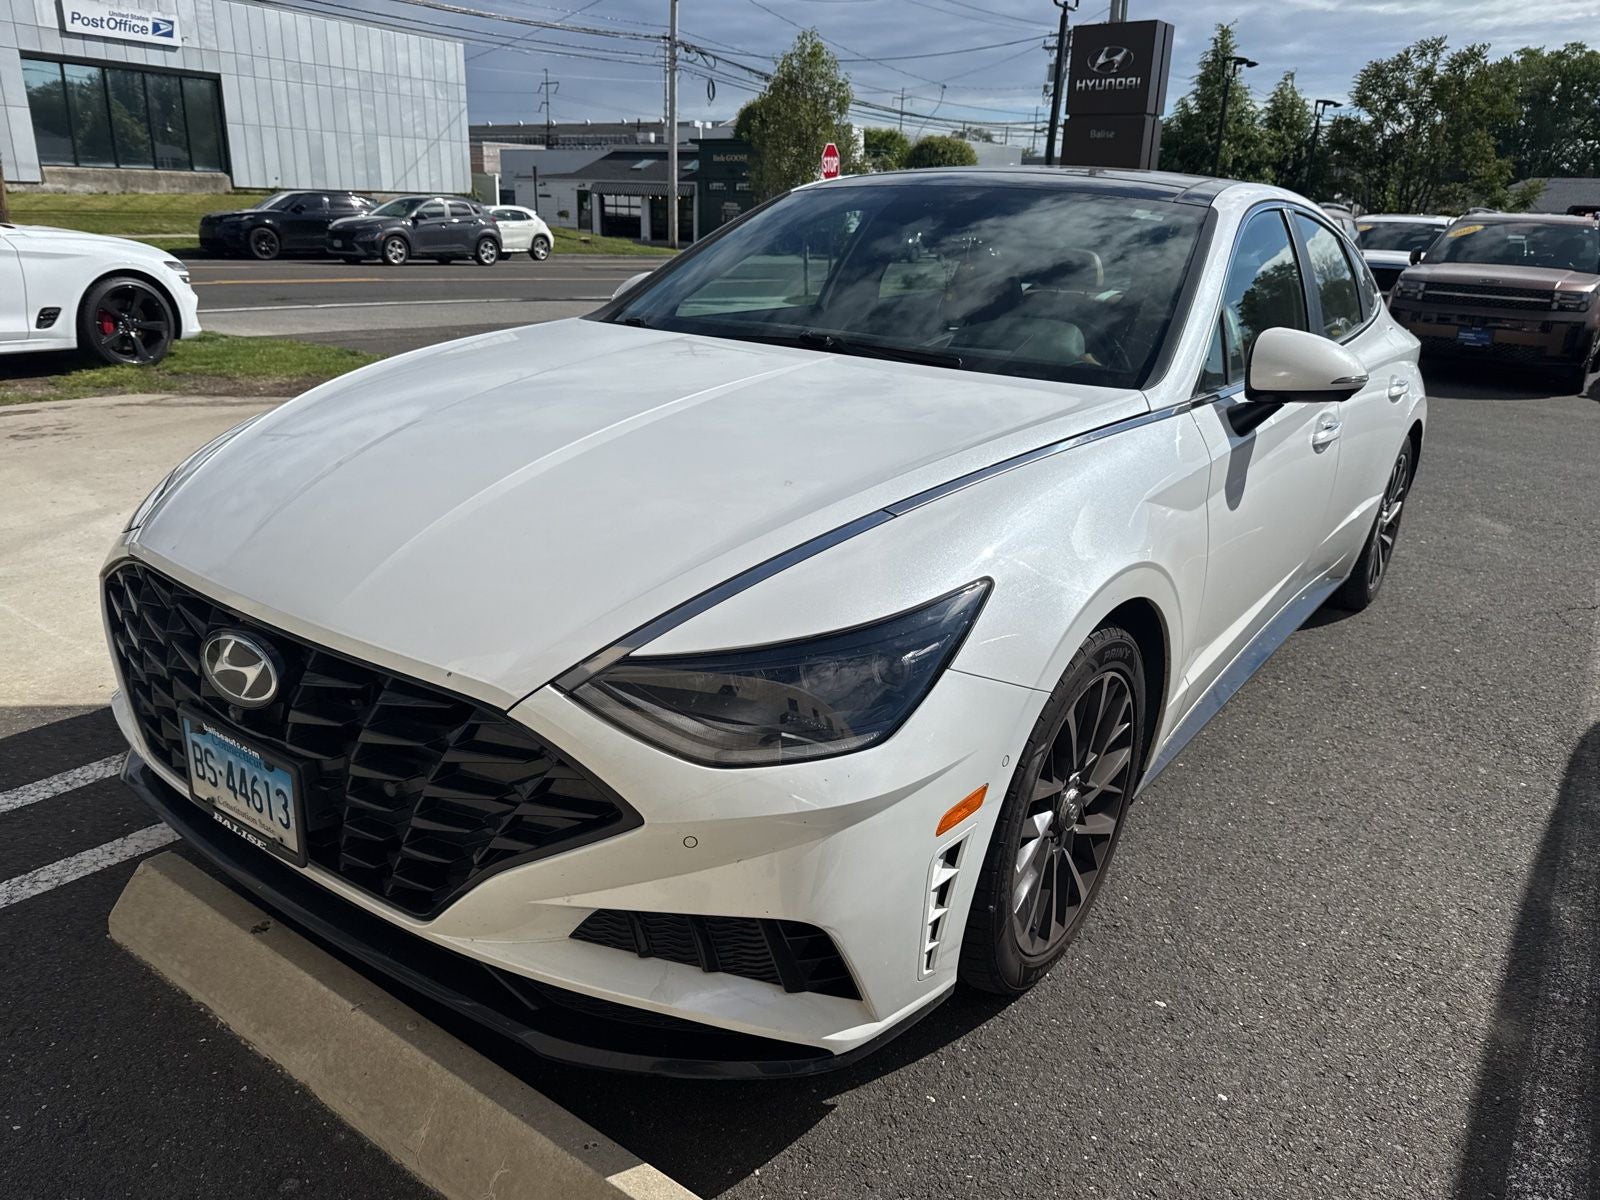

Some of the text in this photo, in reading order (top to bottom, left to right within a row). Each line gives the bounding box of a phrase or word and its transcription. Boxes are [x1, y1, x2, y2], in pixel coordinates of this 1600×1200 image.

[70, 11, 149, 35] Post Office
[108, 10, 149, 22] United States
[1076, 77, 1141, 91] HYUNDAI
[1090, 129, 1115, 138] Balise
[822, 156, 838, 173] STOP
[202, 722, 260, 759] baliseauto.com
[213, 811, 267, 850] BALISE
